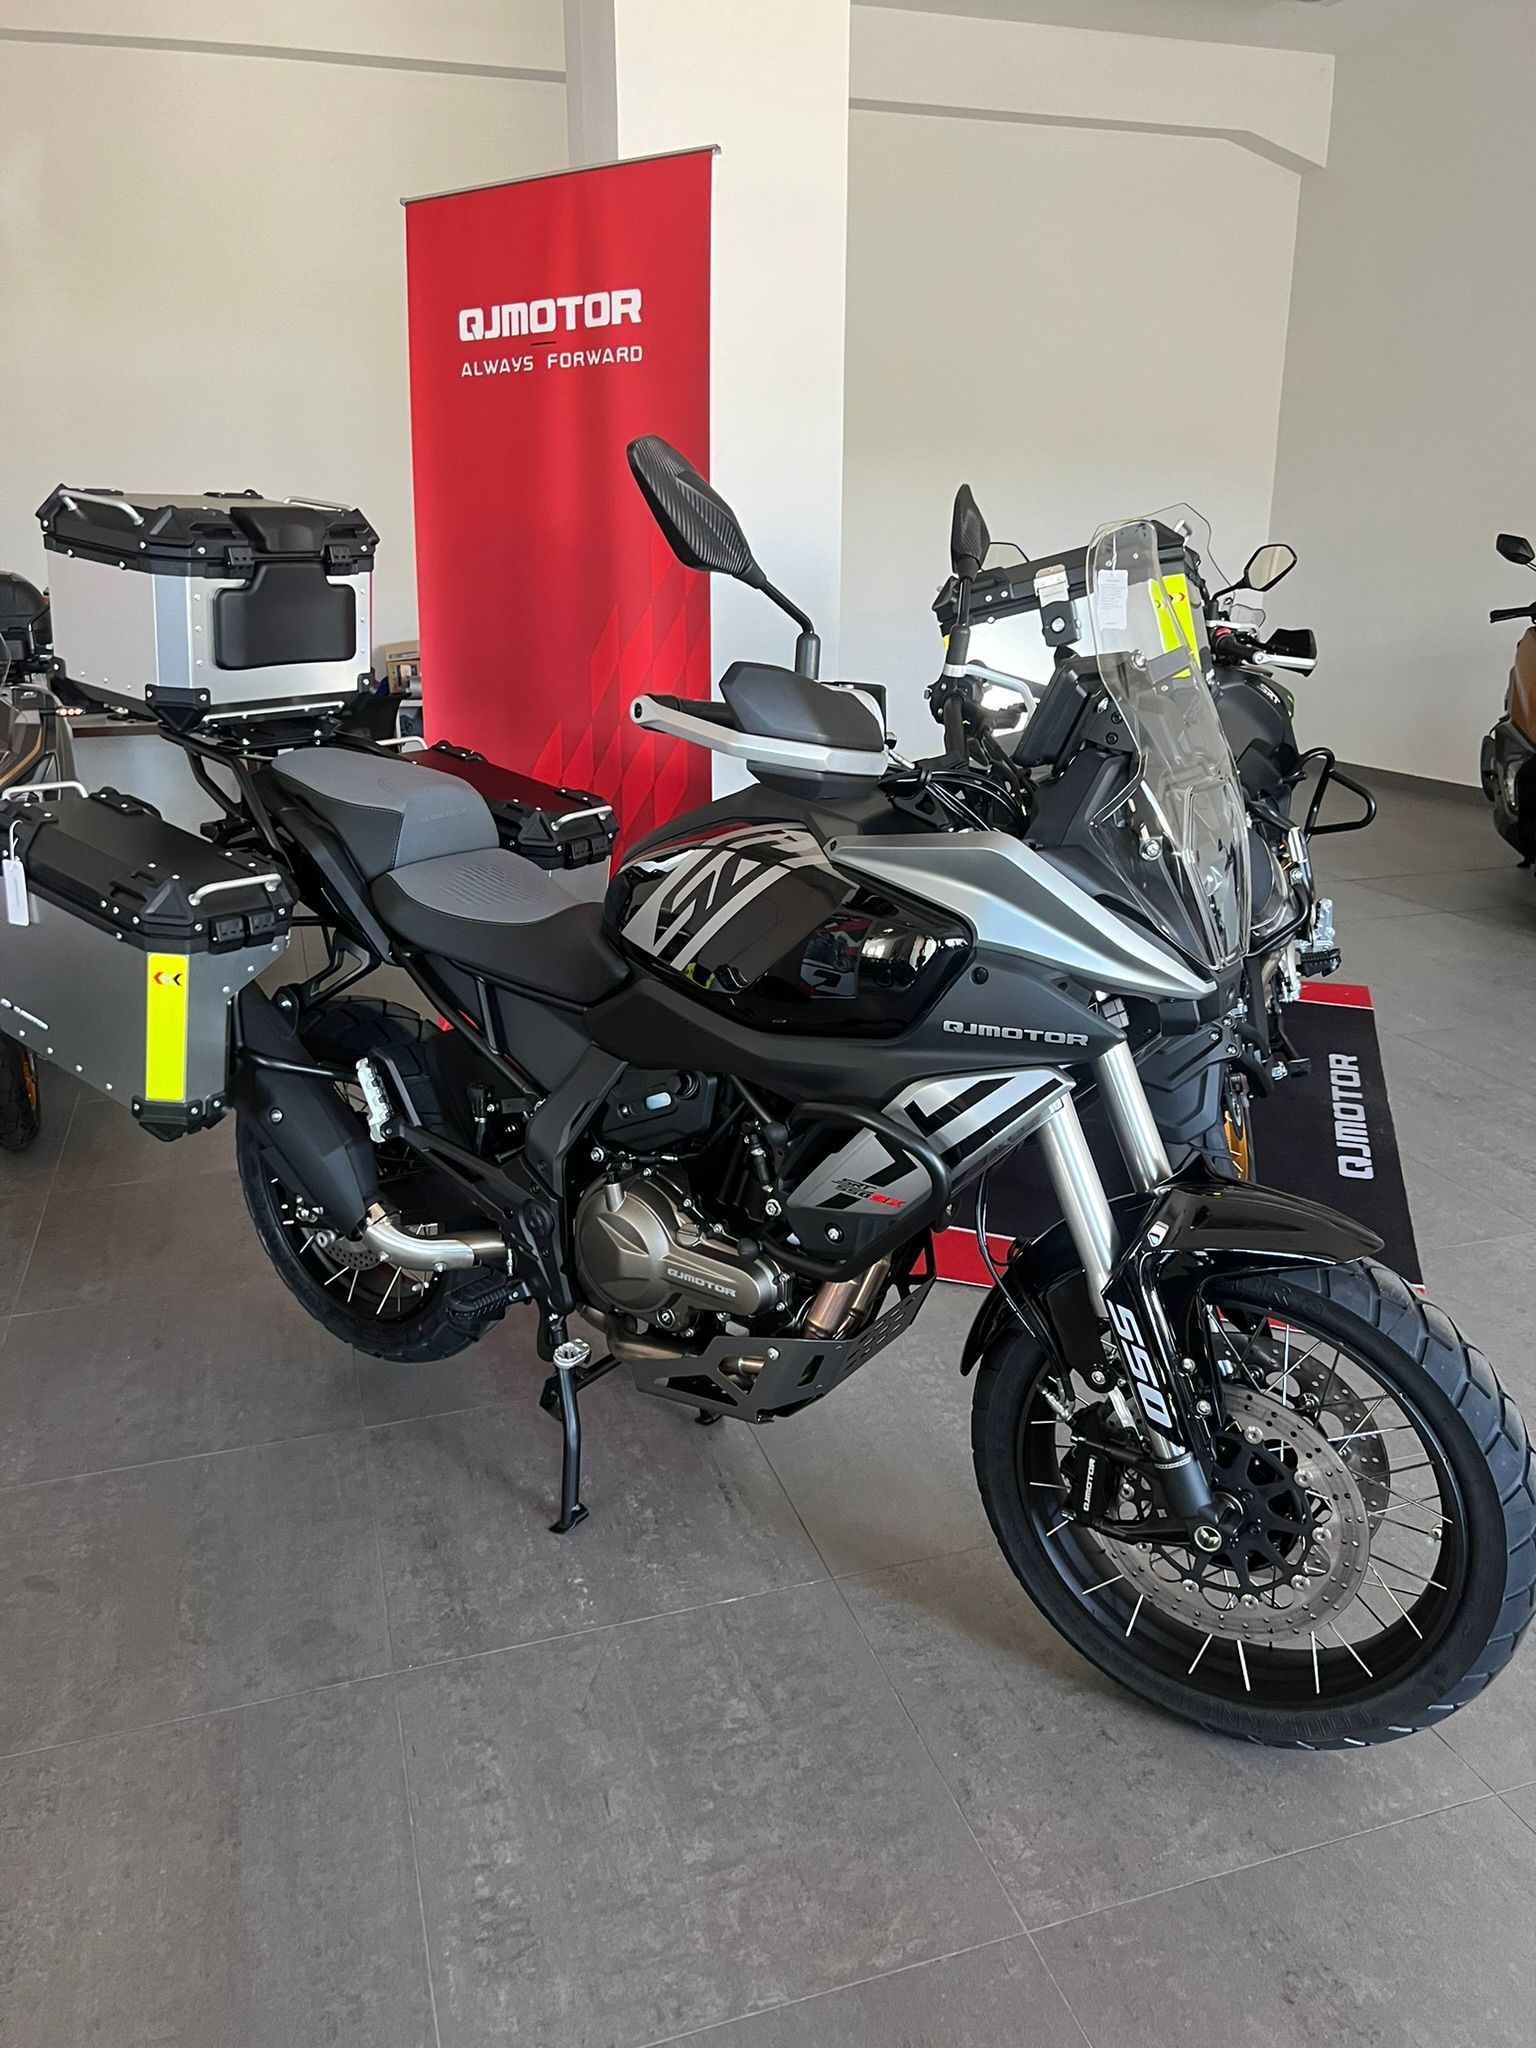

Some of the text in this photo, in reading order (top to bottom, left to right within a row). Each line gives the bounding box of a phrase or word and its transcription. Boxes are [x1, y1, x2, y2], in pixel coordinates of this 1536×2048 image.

[458, 288, 642, 342] QJMOTOR
[461, 345, 643, 378] ALWAYS FORWARD
[942, 1020, 1089, 1046] QJMOTOR
[1328, 1053, 1374, 1180] QJMOTOR
[667, 1267, 737, 1298] QJMOTOR
[1106, 1299, 1173, 1428] 550
[1083, 1457, 1096, 1512] QJMOTOR
